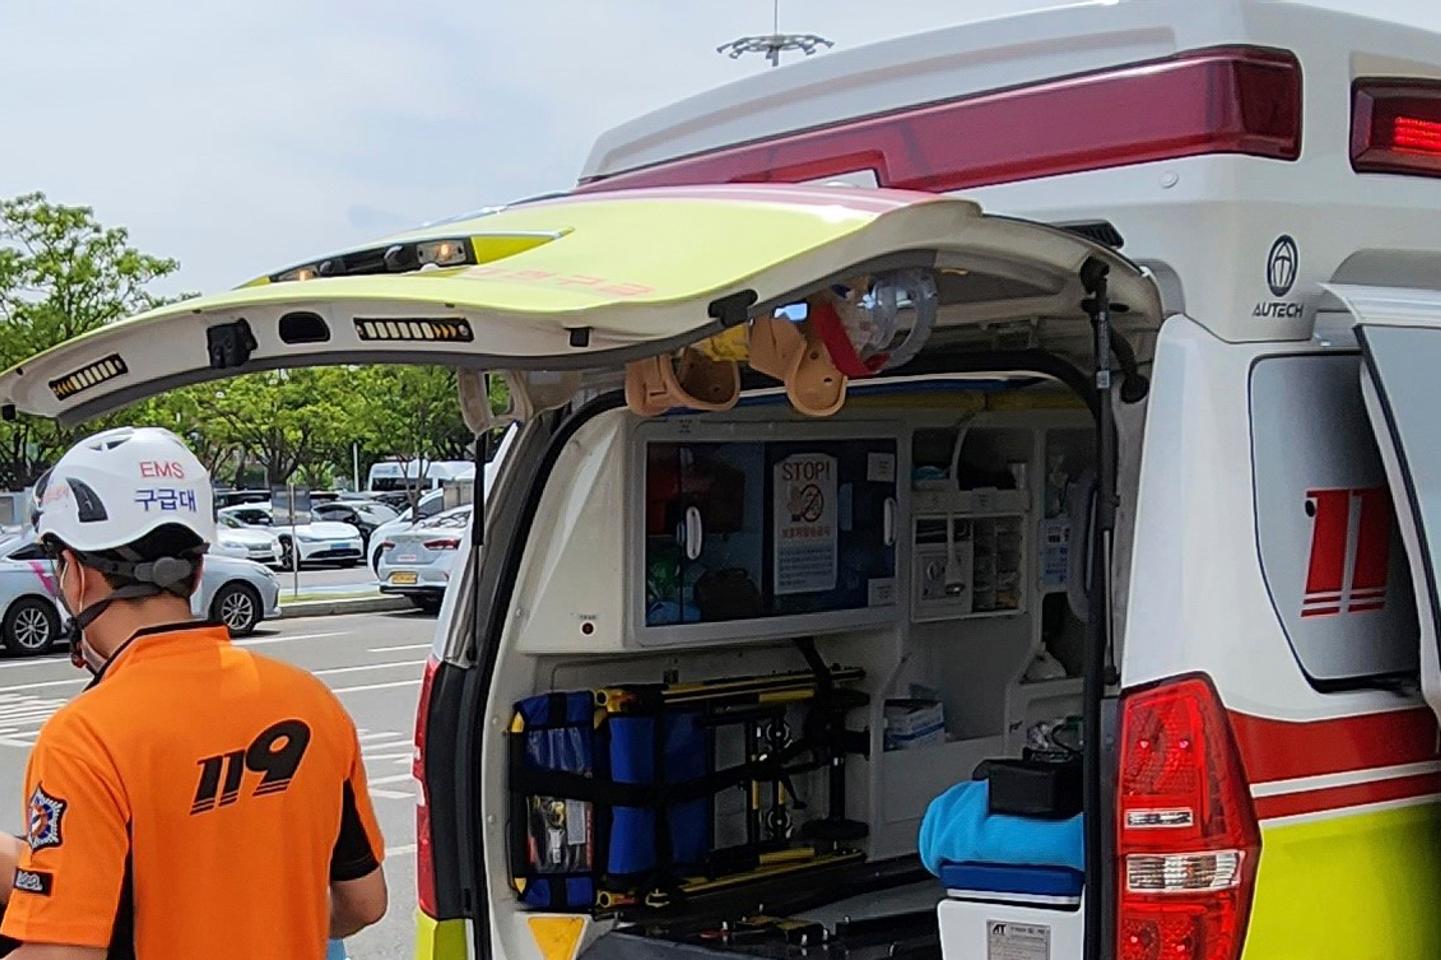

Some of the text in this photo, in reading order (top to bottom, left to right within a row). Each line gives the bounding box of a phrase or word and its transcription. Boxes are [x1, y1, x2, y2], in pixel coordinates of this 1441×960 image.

[1252, 302, 1305, 319] AUTECH
[139, 461, 185, 480] EMS
[782, 461, 831, 481] STOP!
[134, 488, 198, 513] 구급대
[189, 718, 312, 816] 119
